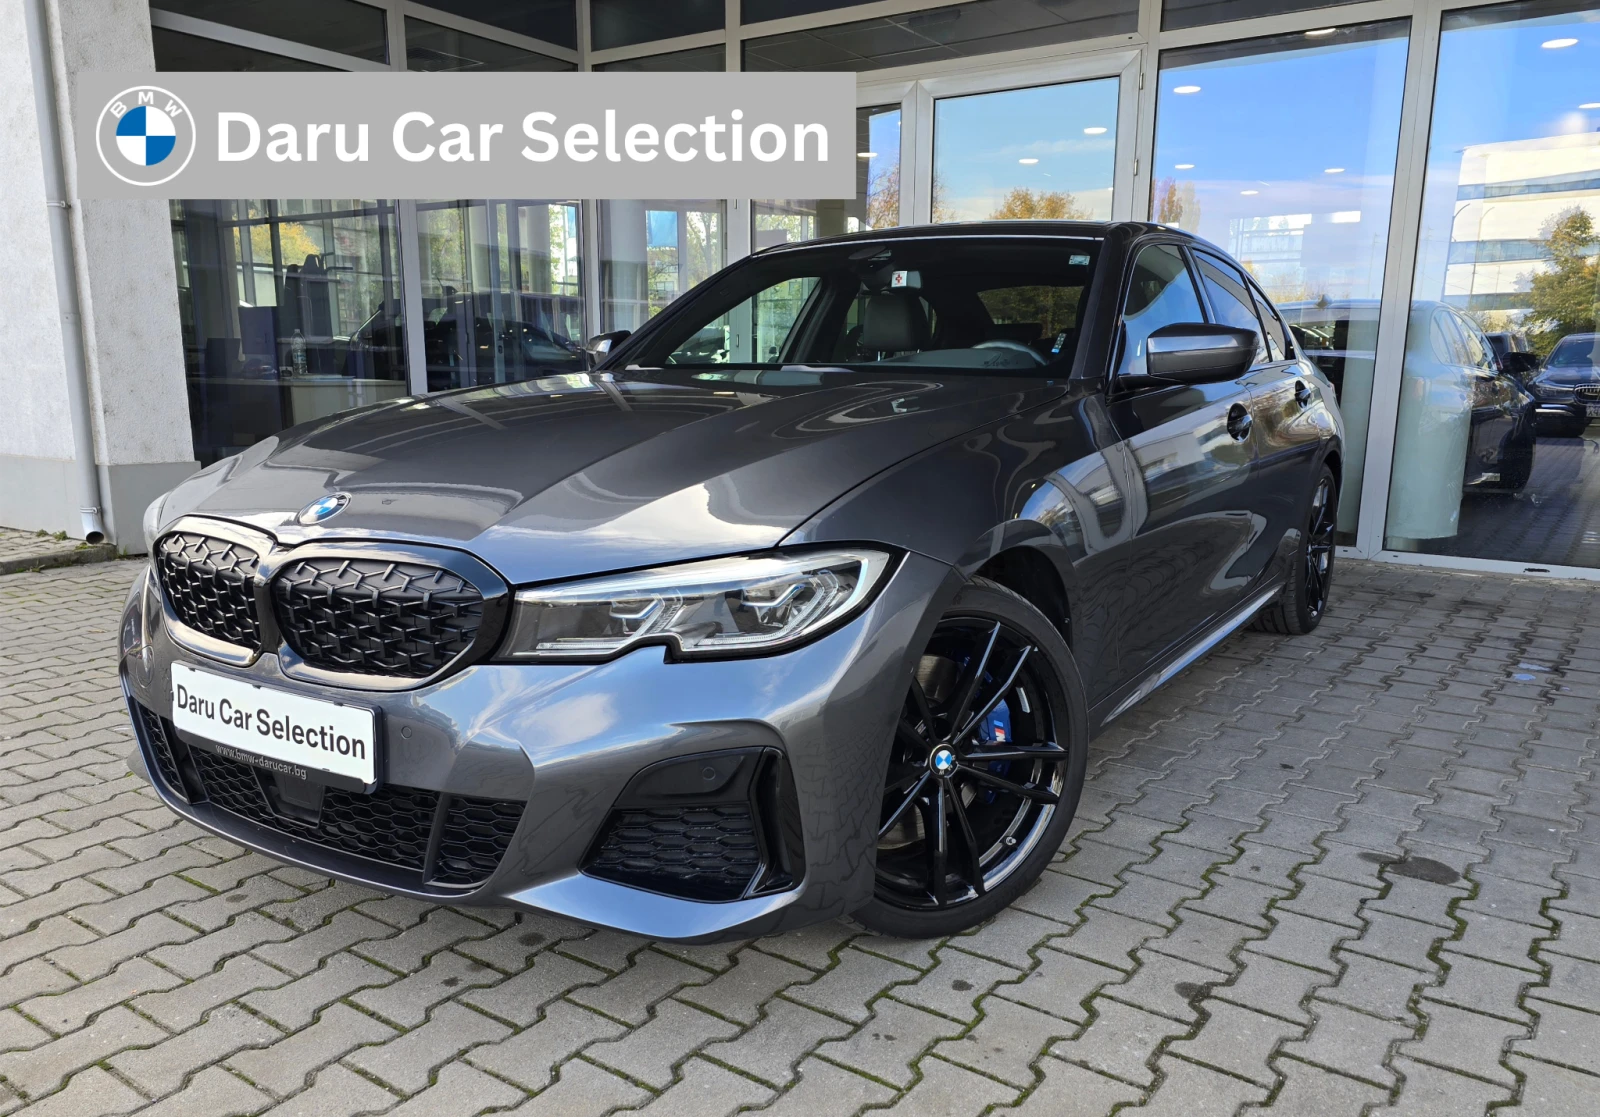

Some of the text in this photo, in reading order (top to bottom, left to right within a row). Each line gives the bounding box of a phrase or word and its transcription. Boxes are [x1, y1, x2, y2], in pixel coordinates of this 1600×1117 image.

[177, 684, 366, 759] Daru Car Selection
[215, 744, 307, 780] www.bmw-darucar.bg
